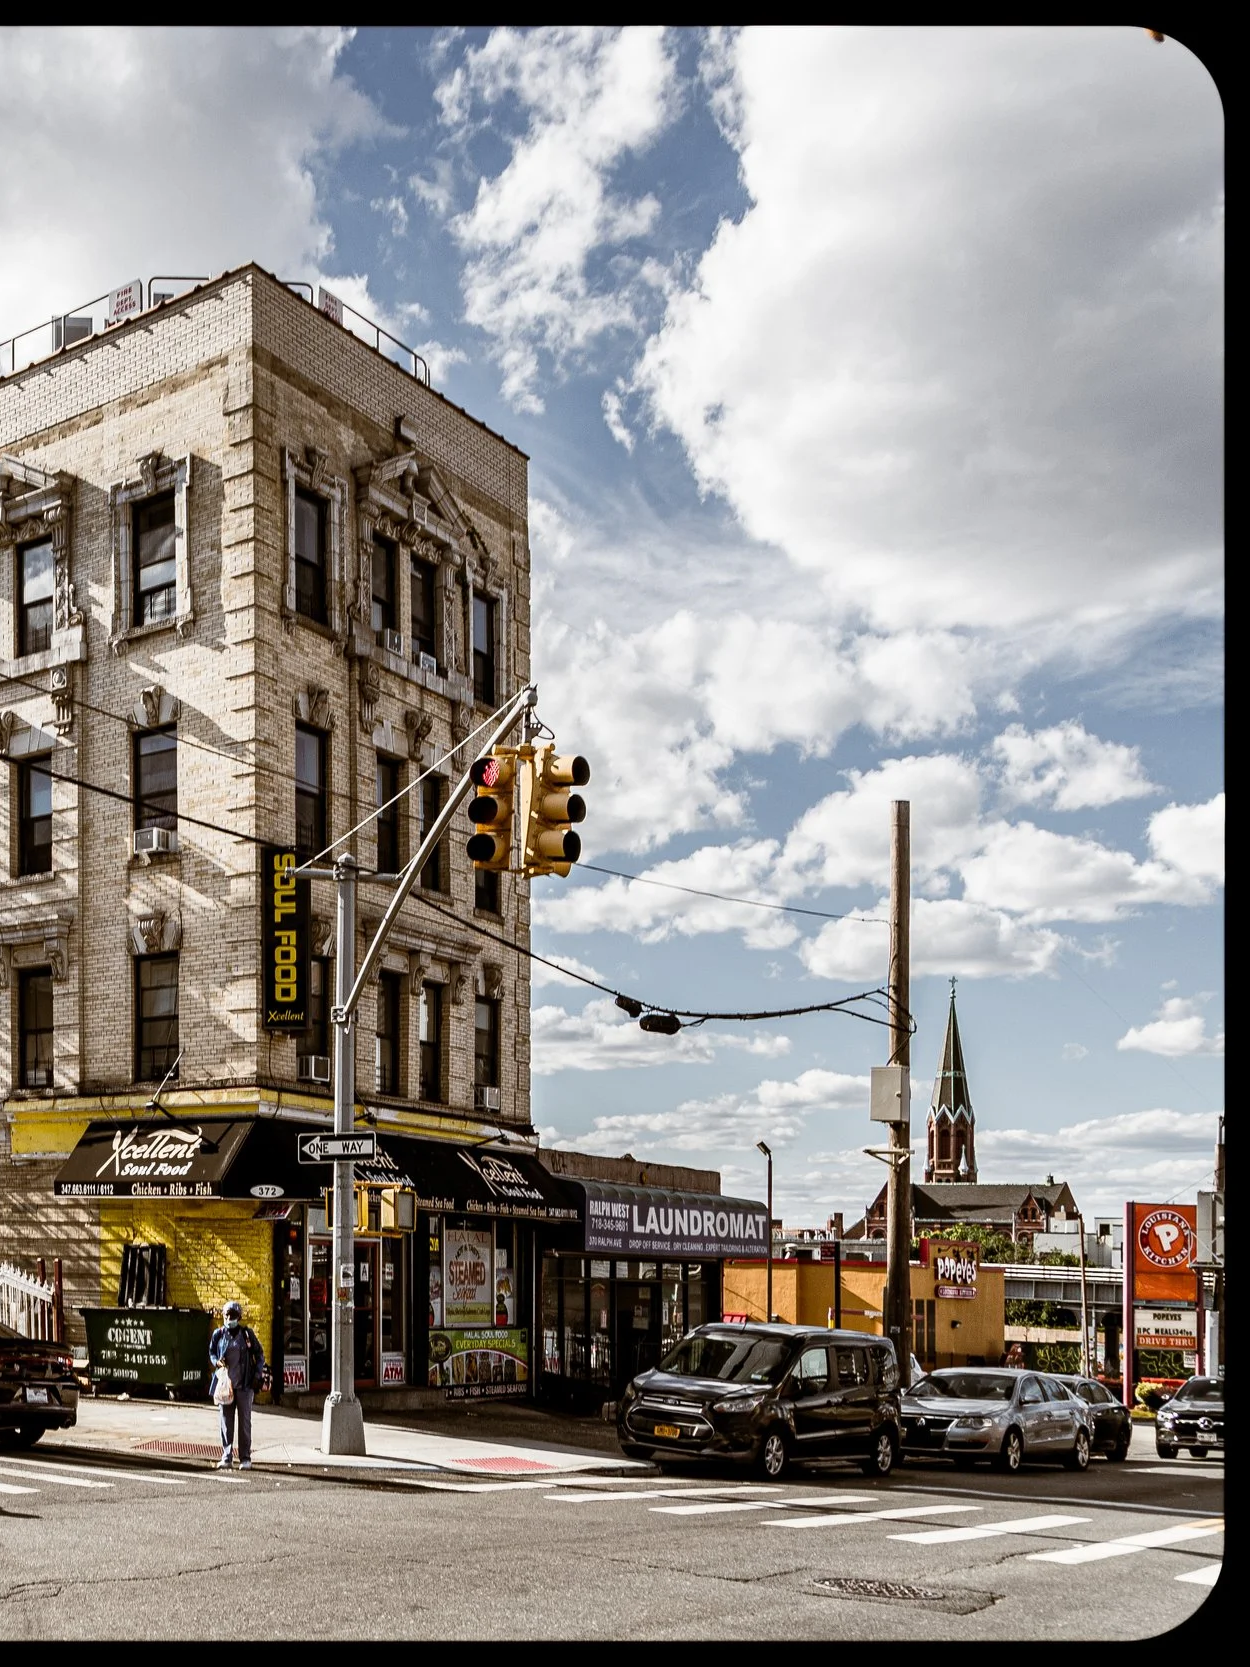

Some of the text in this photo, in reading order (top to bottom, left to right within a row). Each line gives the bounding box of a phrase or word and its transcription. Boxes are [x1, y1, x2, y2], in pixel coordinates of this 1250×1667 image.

[117, 286, 132, 299] FIRE
[114, 301, 136, 316] ACCESS
[274, 853, 297, 1002] SOUL FOOD
[268, 1009, 305, 1023] Xcellent
[96, 1125, 203, 1177] Xcellent
[309, 1141, 363, 1154] ONE WAY
[121, 1161, 193, 1176] Soul Food
[457, 1149, 528, 1196] Xcellent
[131, 1181, 212, 1196] Chicken Ribs Fish
[258, 1187, 277, 1196] 372
[443, 1197, 454, 1210] Food
[467, 1200, 483, 1212] Chicken
[500, 1203, 509, 1214] Fish
[512, 1204, 529, 1216] Steamed
[537, 1206, 547, 1217] Food
[589, 1200, 630, 1219] RALPH WEST
[632, 1205, 767, 1240] LAUNDROMAT
[447, 1231, 488, 1243] HALAL
[597, 1237, 613, 1248] RALPH
[613, 1238, 622, 1248] AVE
[1154, 1223, 1179, 1252] P
[629, 1239, 643, 1249] DROP
[642, 1240, 651, 1250] OFF
[651, 1240, 671, 1251] SERVICE
[673, 1242, 682, 1251] DRY
[682, 1242, 704, 1252] CLEANING
[705, 1243, 721, 1252] EXPERT
[721, 1244, 742, 1253] TAILORING
[745, 1245, 768, 1254] ALTERATION
[1143, 1245, 1189, 1264] KITCHEN
[361, 1264, 368, 1277] A
[448, 1260, 486, 1286] STEAMED
[1153, 1312, 1182, 1321] POPEYES
[107, 1328, 153, 1346] COGENT
[463, 1330, 509, 1339] HALAL SOUL FOOD
[1142, 1327, 1150, 1335] PC
[455, 1340, 488, 1349] EVERYDAY
[488, 1339, 516, 1349] SPECIALS
[1139, 1336, 1194, 1347] DRIVE THRU
[283, 1371, 305, 1385] ATM
[383, 1367, 404, 1380] ATM
[453, 1387, 465, 1397] RIBS
[469, 1386, 481, 1395] FISH
[485, 1385, 506, 1394] STEAMED
[507, 1383, 528, 1393] SEAFOOD
